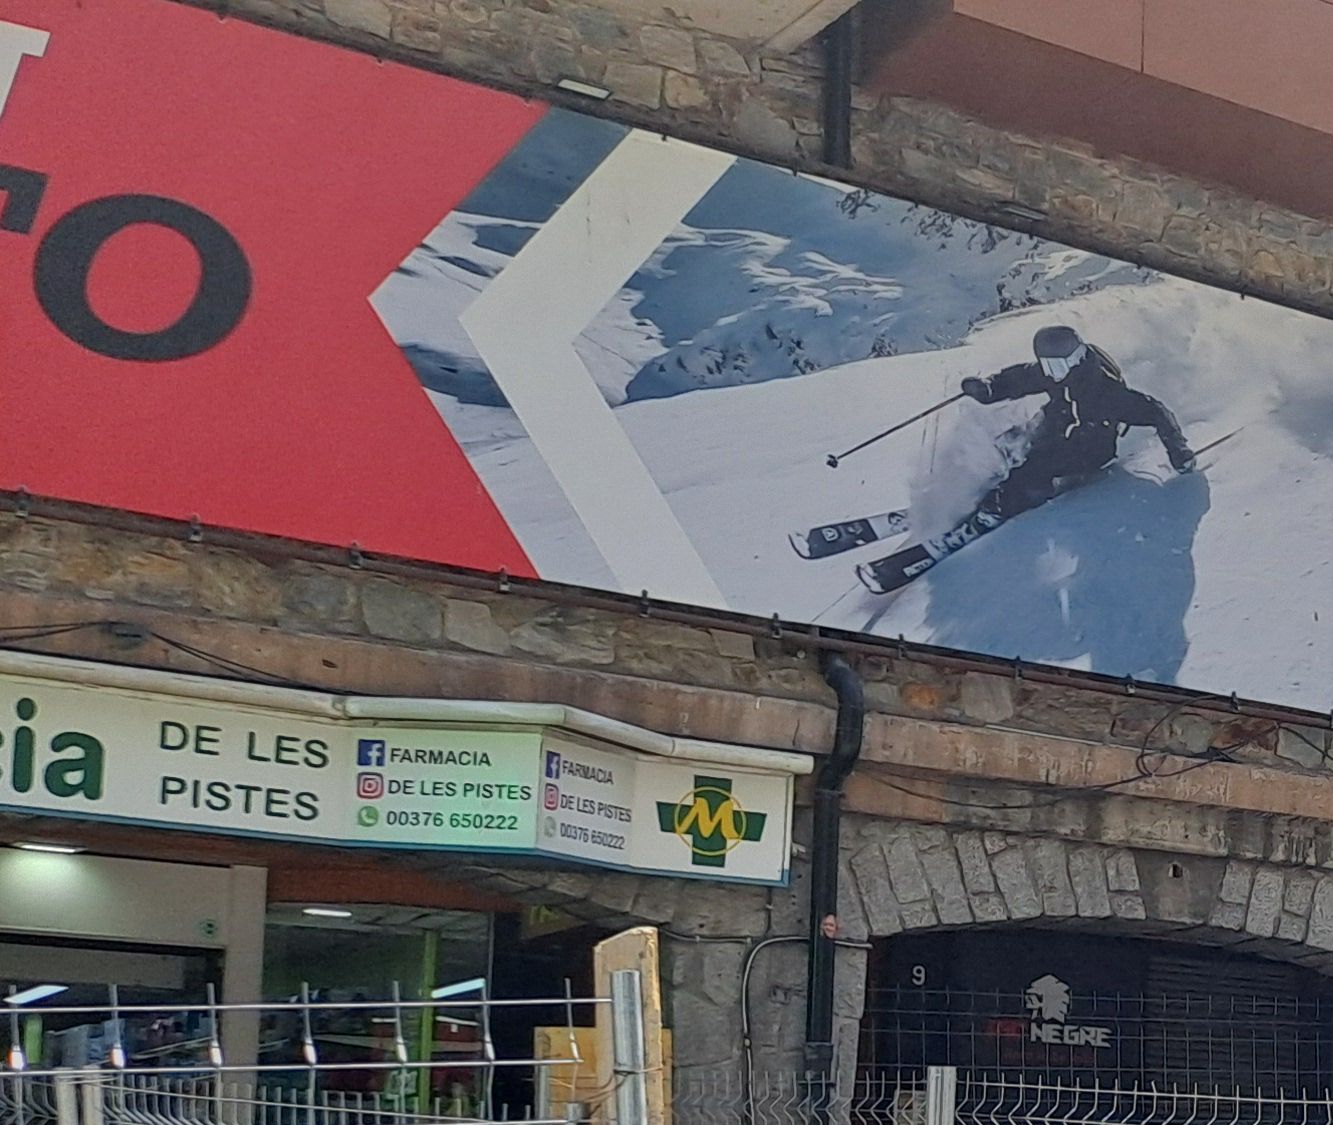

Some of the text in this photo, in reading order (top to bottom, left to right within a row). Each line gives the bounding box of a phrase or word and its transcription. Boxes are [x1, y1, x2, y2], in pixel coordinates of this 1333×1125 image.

[0, 697, 104, 801] ia
[160, 720, 330, 769] DE LES
[389, 748, 492, 767] FARMACIA
[561, 760, 615, 785] FARMACIA
[160, 775, 320, 821] PISTES
[387, 779, 532, 801] DE LES PISTES
[386, 811, 518, 831] 00376 650222
[560, 793, 633, 823] DE LES PISTES
[560, 822, 626, 850] 00376 650222
[912, 964, 926, 986] 9
[1029, 1022, 1113, 1049] NEGRE
